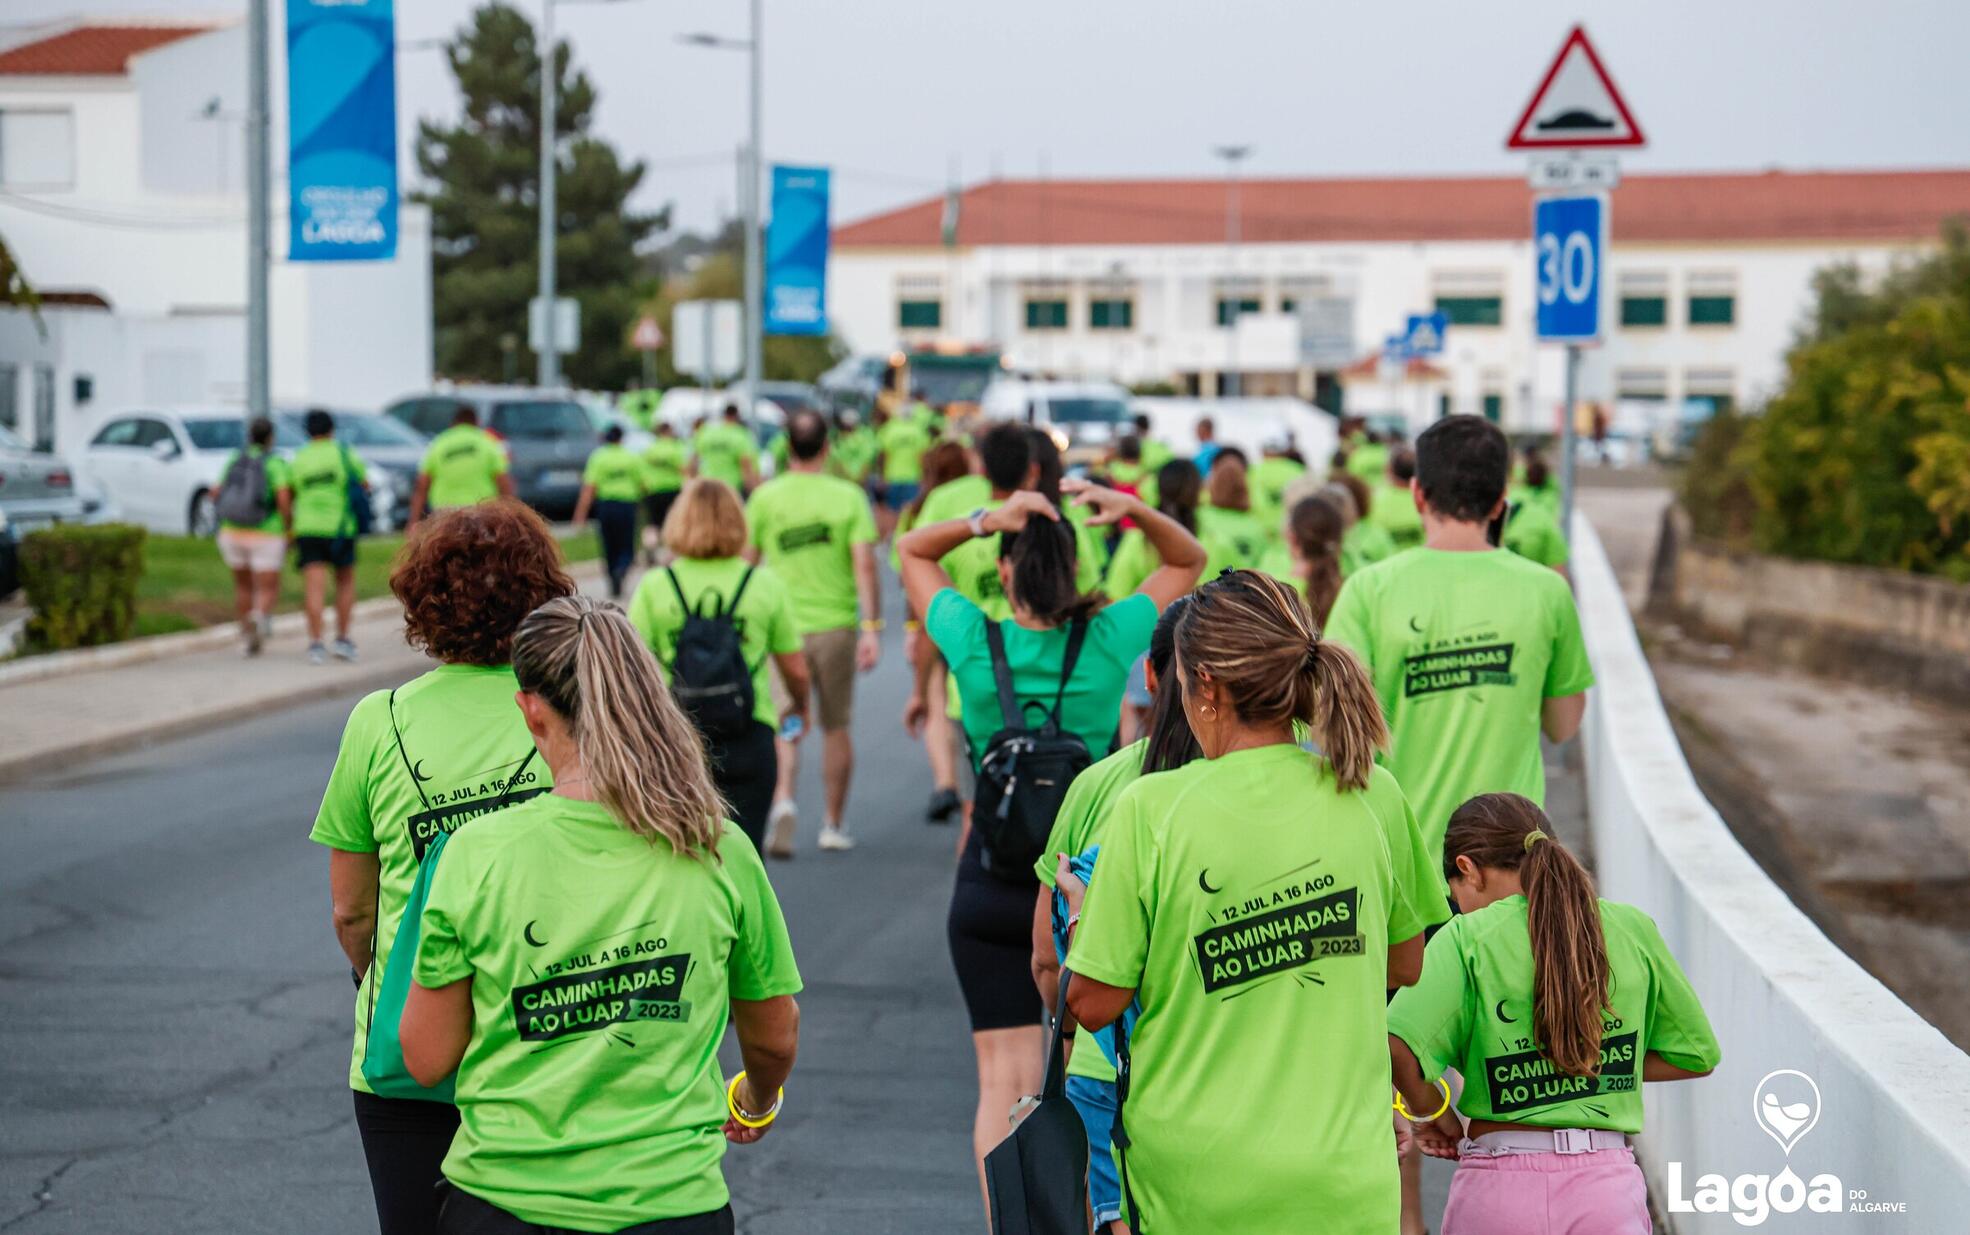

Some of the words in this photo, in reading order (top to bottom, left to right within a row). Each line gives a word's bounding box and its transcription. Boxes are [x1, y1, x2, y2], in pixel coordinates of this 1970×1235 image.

[1538, 230, 1594, 305] 30
[1407, 650, 1507, 676] CAMINHADAS
[1431, 670, 1472, 688] LUAR
[432, 793, 447, 806] 12
[450, 787, 476, 802] JUL
[479, 784, 489, 795] A
[491, 779, 505, 791] 16
[1222, 906, 1239, 921] 12
[1241, 897, 1270, 915] JUL
[1272, 891, 1284, 905] A
[1285, 885, 1301, 900] 16
[1305, 874, 1335, 895] AGO
[1204, 901, 1350, 958] CAMINHADAS
[545, 963, 563, 976] 12
[566, 954, 596, 971] JUL
[600, 951, 610, 963] A
[613, 945, 631, 960] 16
[635, 938, 667, 955] AGO
[1212, 958, 1242, 983] AO
[1245, 940, 1305, 972] LUAR
[1320, 939, 1361, 955] 2023
[522, 966, 676, 1010] CAMINHADAS
[529, 1014, 560, 1033] AO
[563, 1001, 624, 1029] LUAR
[637, 1003, 681, 1019] 2023
[1515, 1037, 1530, 1050] 12
[1602, 1018, 1623, 1033] GO
[1500, 1086, 1529, 1105] AO
[1533, 1076, 1589, 1099] LUAR
[1606, 1077, 1634, 1091] 2023
